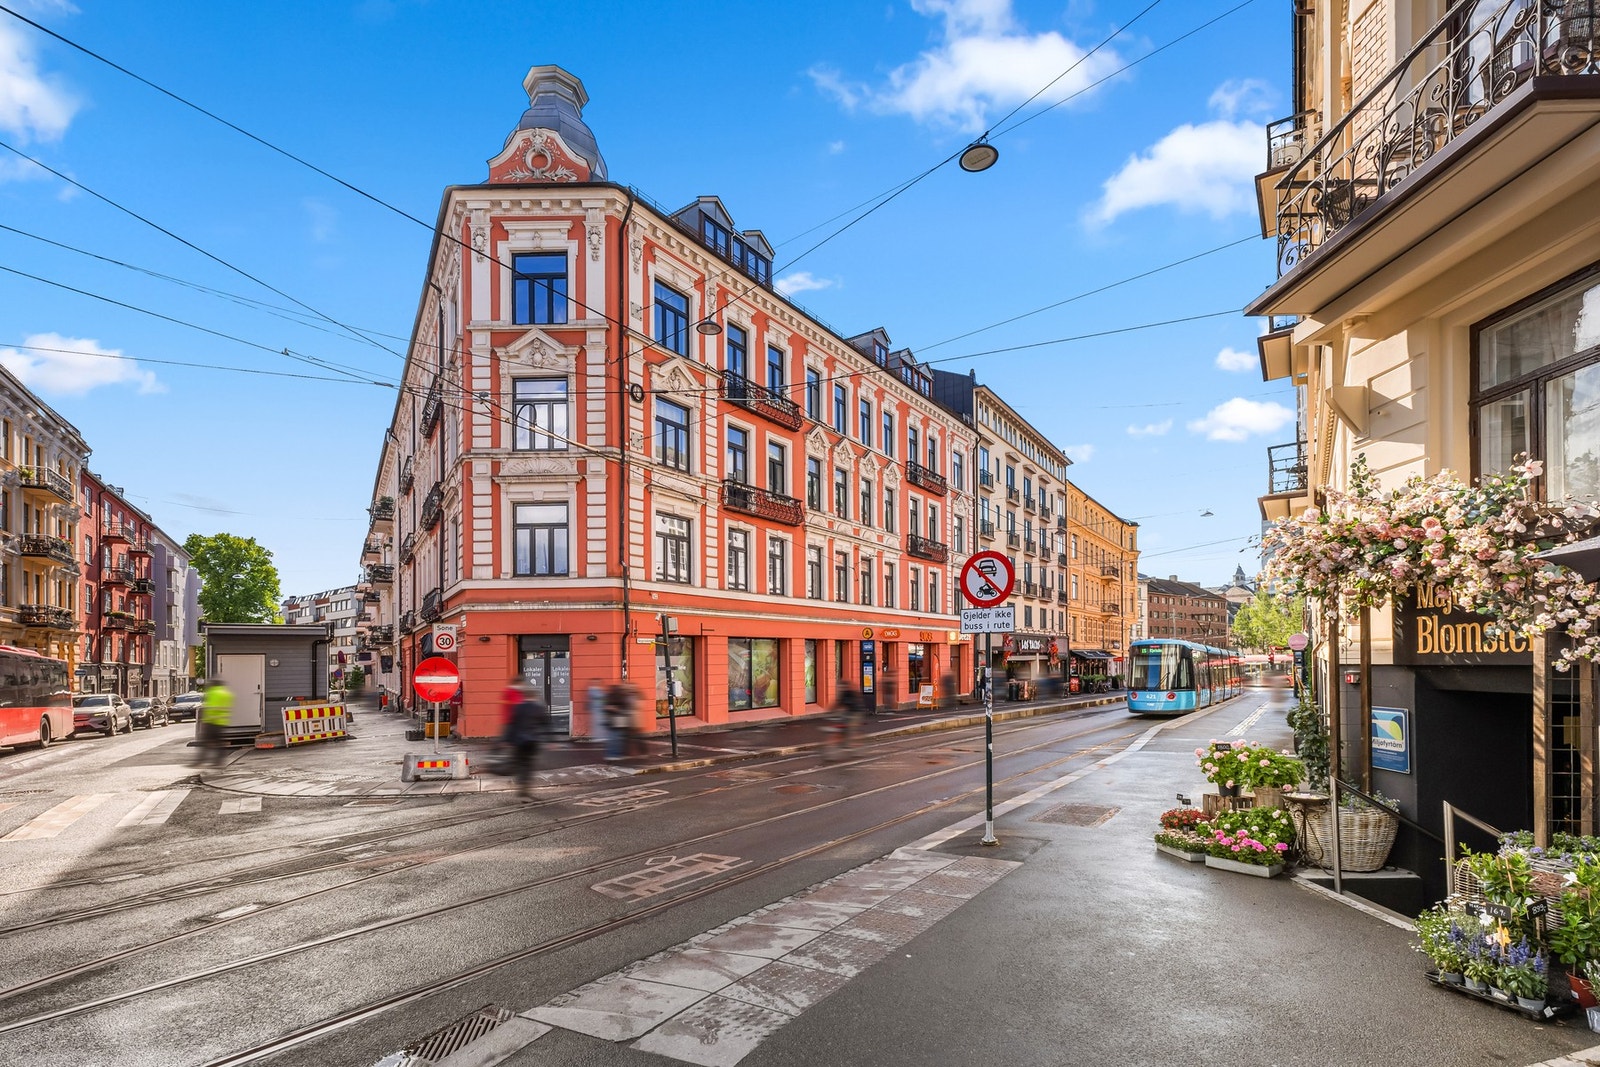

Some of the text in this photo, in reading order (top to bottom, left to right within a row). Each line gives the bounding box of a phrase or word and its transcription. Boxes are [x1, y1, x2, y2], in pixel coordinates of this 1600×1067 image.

[963, 610, 1011, 621] Gjelder ikke
[964, 622, 983, 630] buss
[993, 621, 1011, 629] rute
[439, 637, 452, 646] 30
